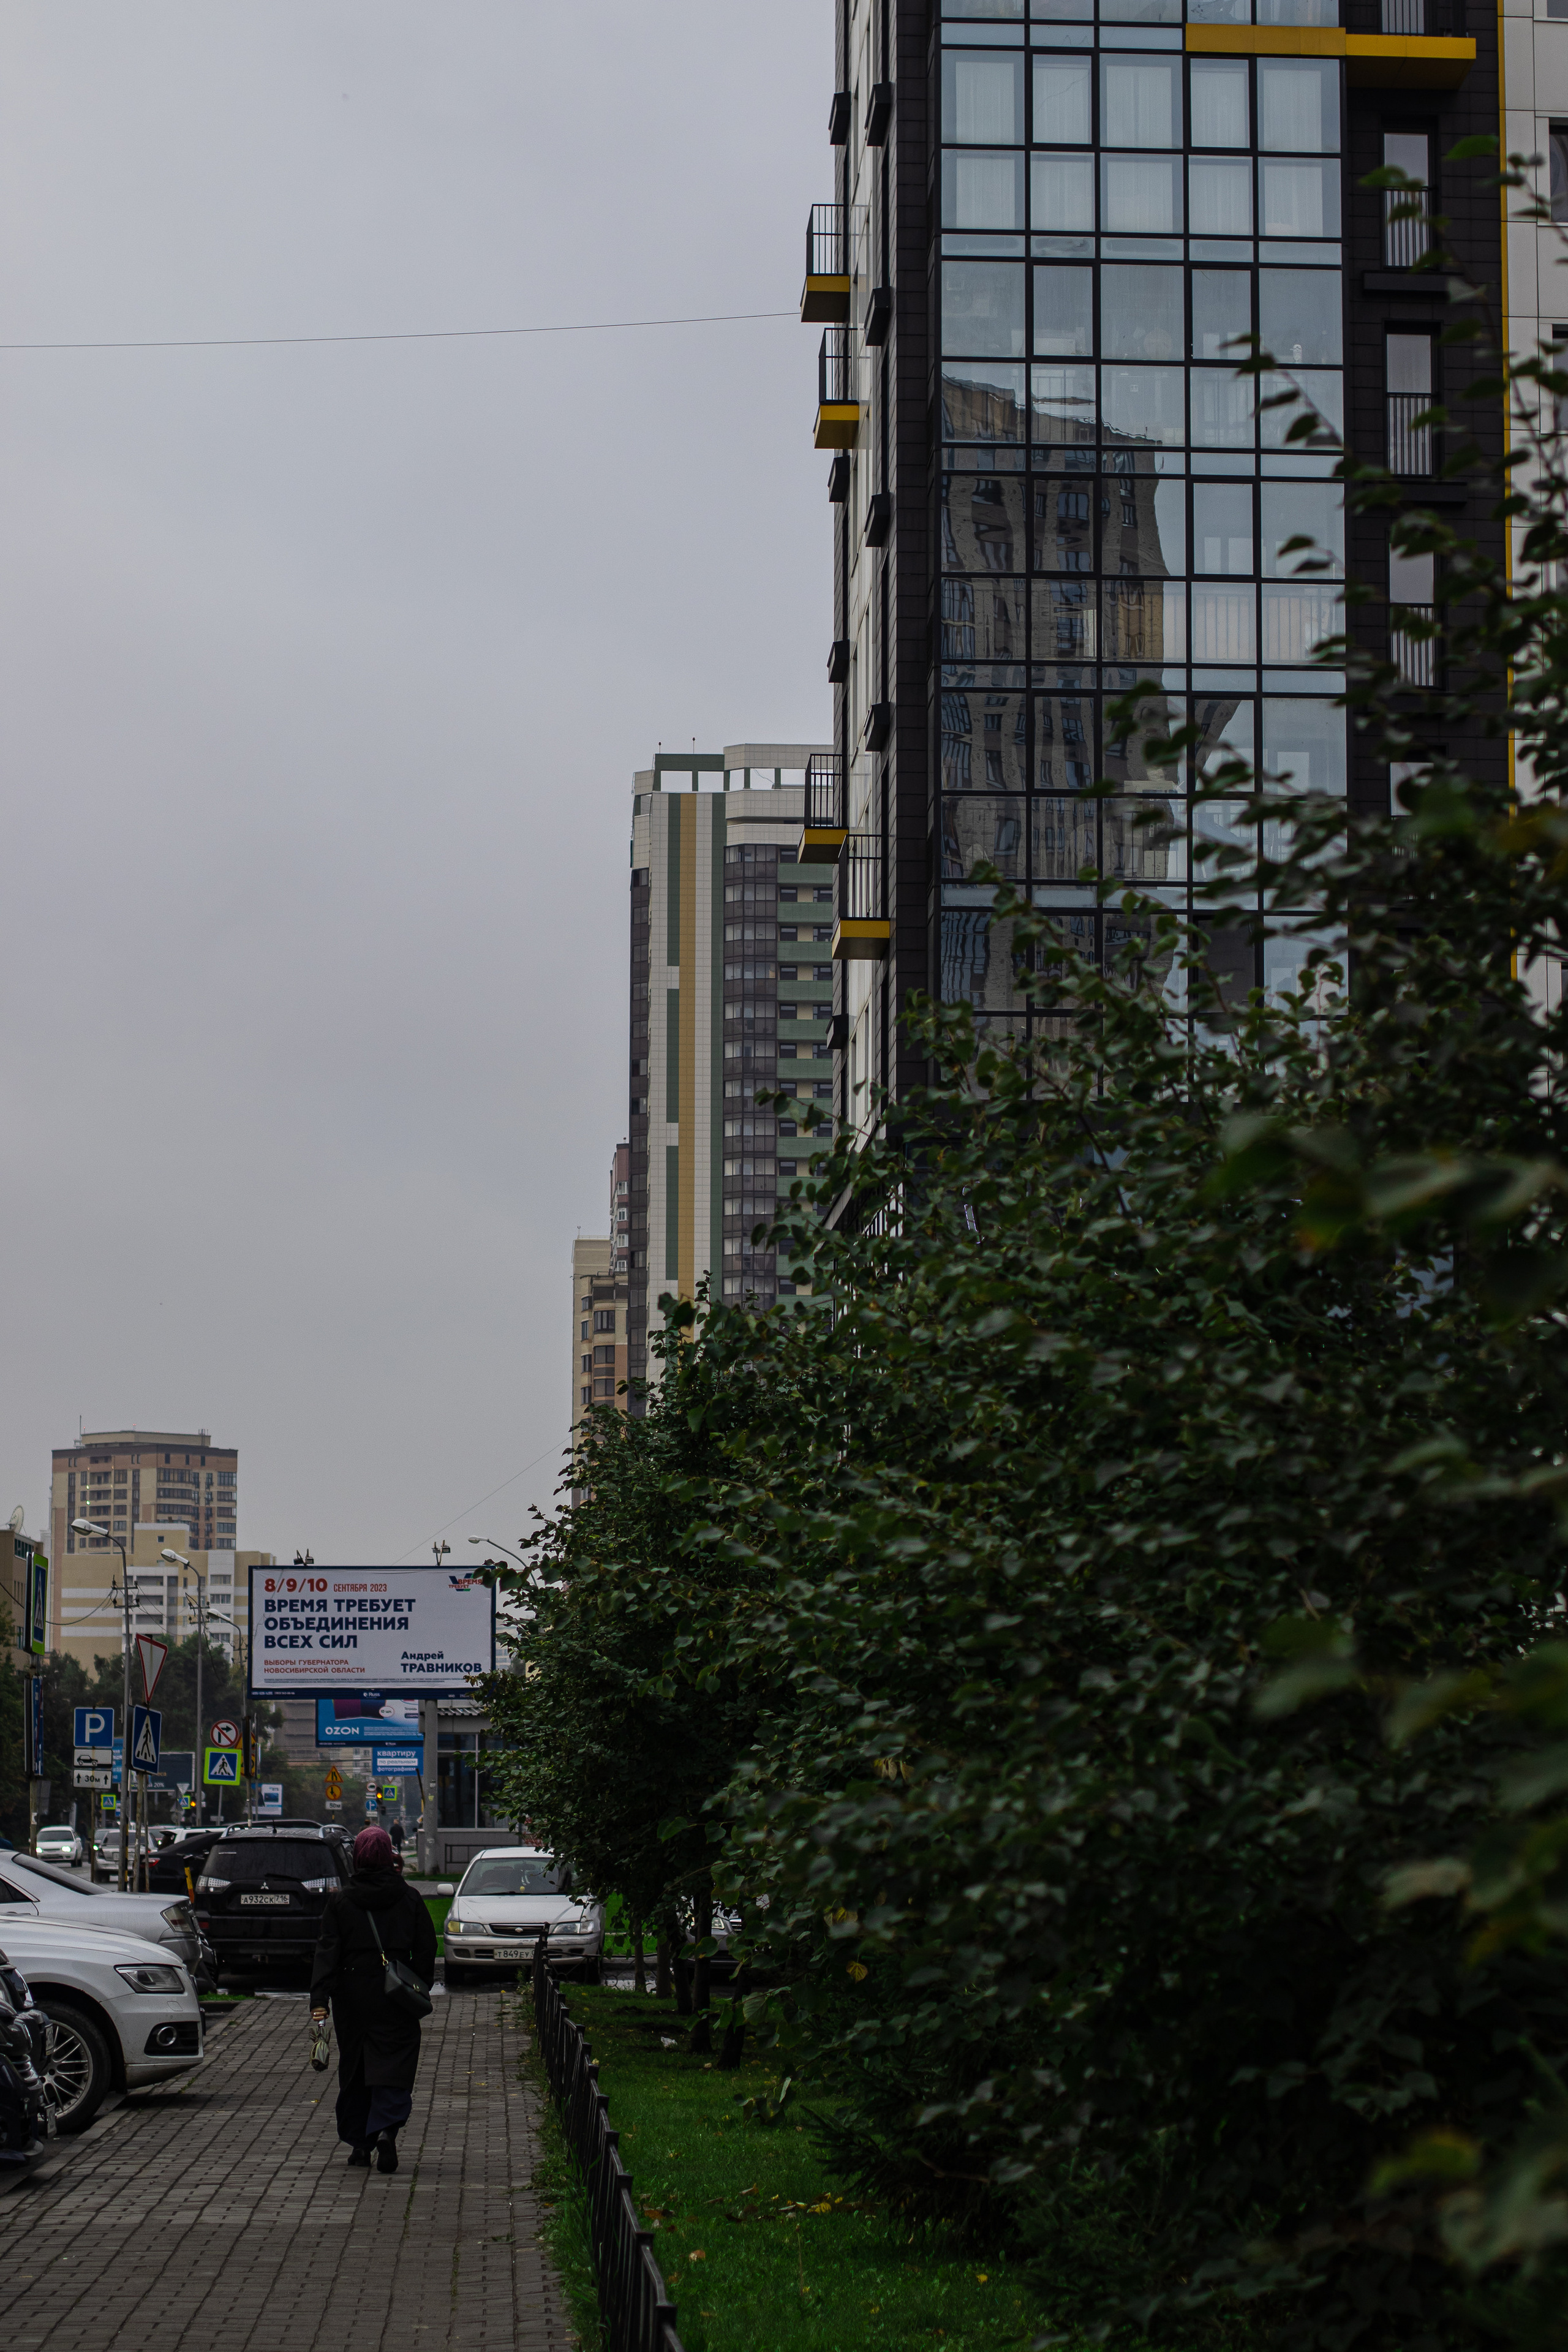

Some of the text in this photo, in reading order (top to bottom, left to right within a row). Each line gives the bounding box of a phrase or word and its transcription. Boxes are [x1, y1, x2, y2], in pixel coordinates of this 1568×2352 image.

[265, 1578, 328, 1593] 8/9/10
[265, 1599, 416, 1612] ВРЕМЯ ТРЕБУЕТ
[265, 1617, 409, 1632] ОБЪЕДИНЕНИЯ
[265, 1635, 357, 1648] ВСЕХ СИЛ
[401, 1651, 443, 1661] Андрей
[401, 1663, 482, 1673] ТРАВНИКОВ
[85, 1713, 105, 1743] P
